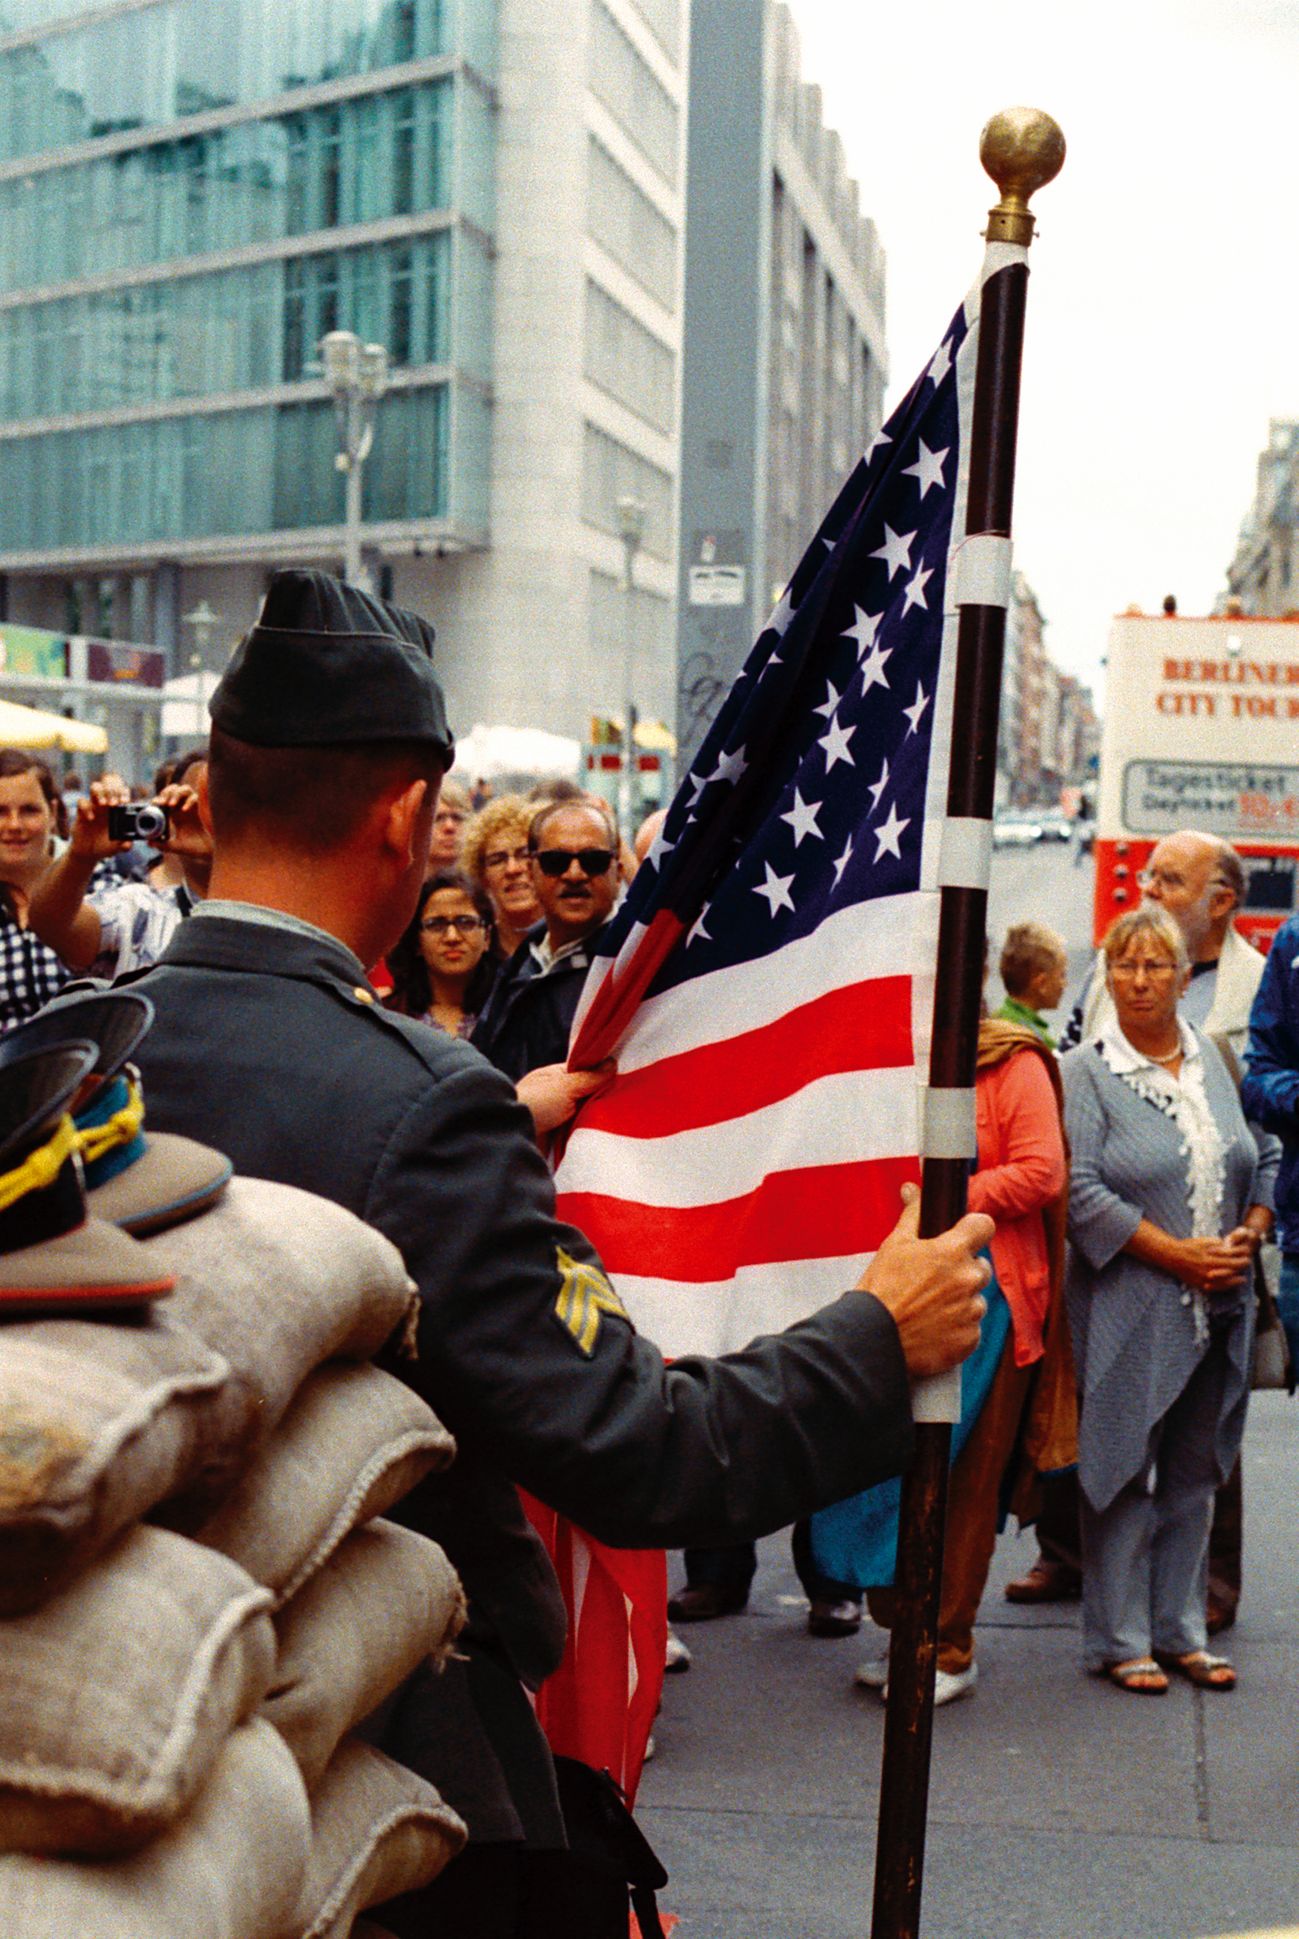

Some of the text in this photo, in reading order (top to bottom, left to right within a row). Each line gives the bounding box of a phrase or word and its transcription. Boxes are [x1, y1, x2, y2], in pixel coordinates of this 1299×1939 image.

[1162, 658, 1299, 685] BERLINER
[1155, 691, 1299, 720] CITY TOUR
